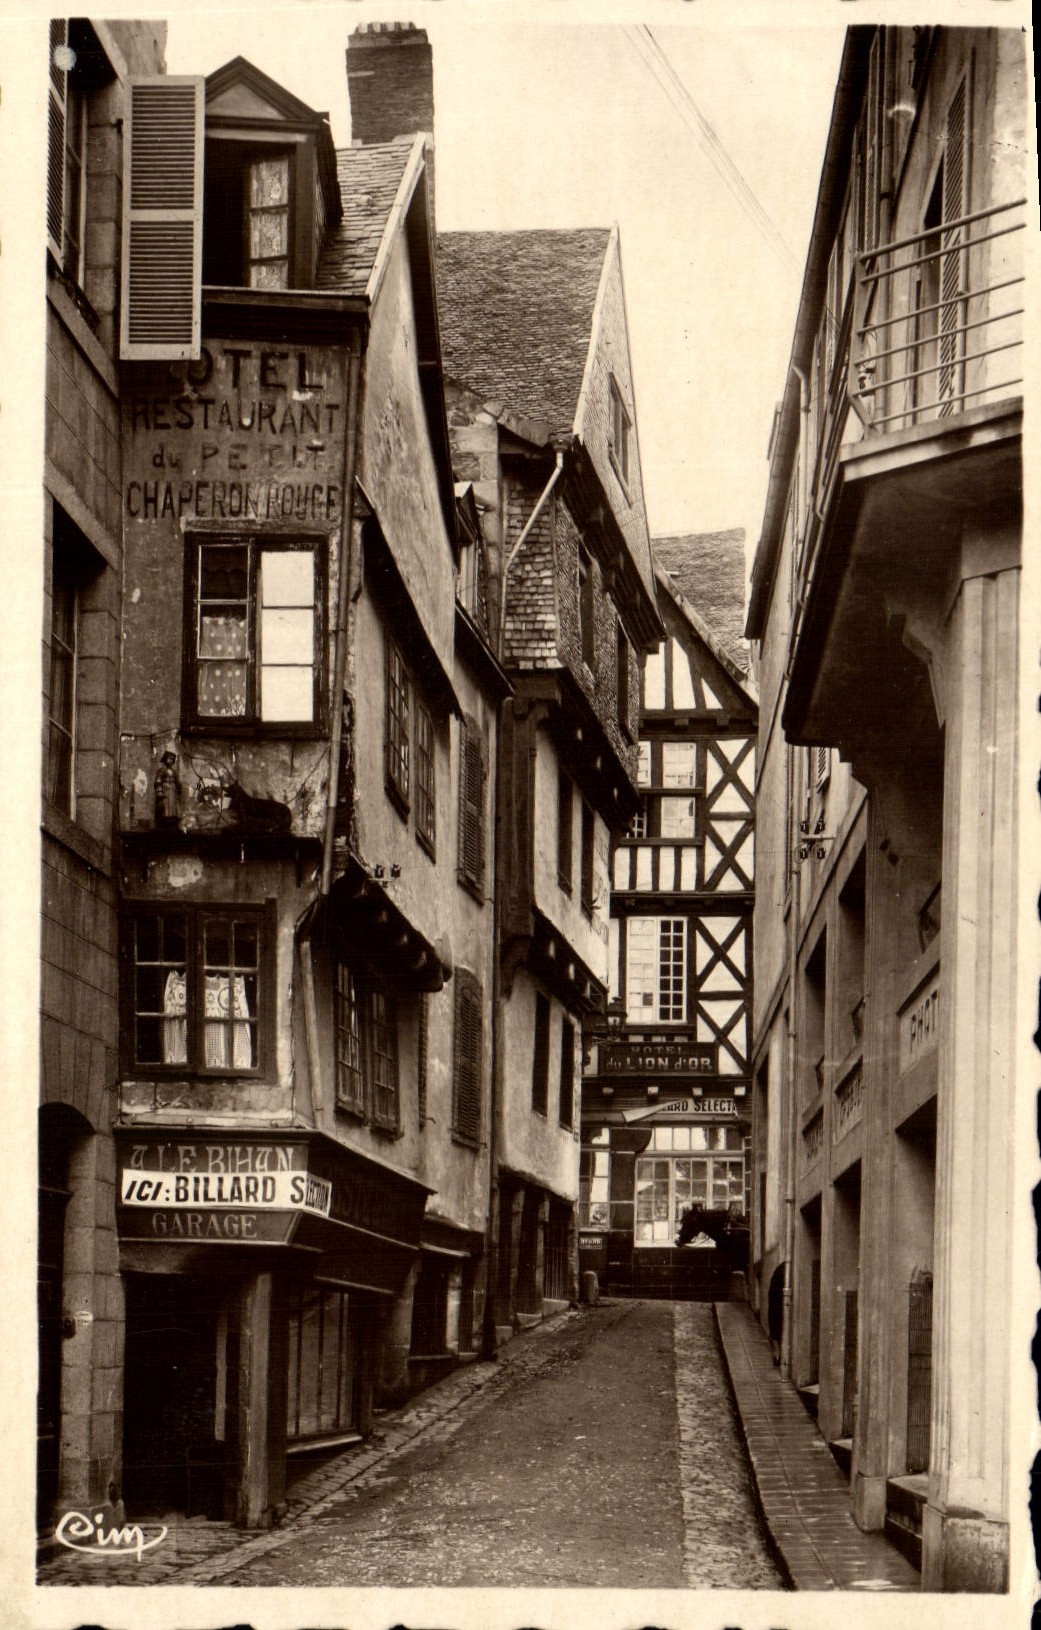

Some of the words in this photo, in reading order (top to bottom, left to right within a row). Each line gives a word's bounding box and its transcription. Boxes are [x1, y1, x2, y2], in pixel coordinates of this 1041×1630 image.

[187, 347, 324, 389] OTEL
[132, 399, 340, 434] RESTAURANT
[152, 442, 182, 469] du
[202, 443, 325, 472] PETIT
[127, 481, 259, 520] CHAPERON
[910, 988, 940, 1054] PHOT
[625, 1056, 670, 1071] LION
[674, 1056, 713, 1071] d'OR
[630, 1045, 687, 1055] HOTEL
[175, 1176, 276, 1203] BILLARD
[152, 1212, 257, 1239] GARAGE
